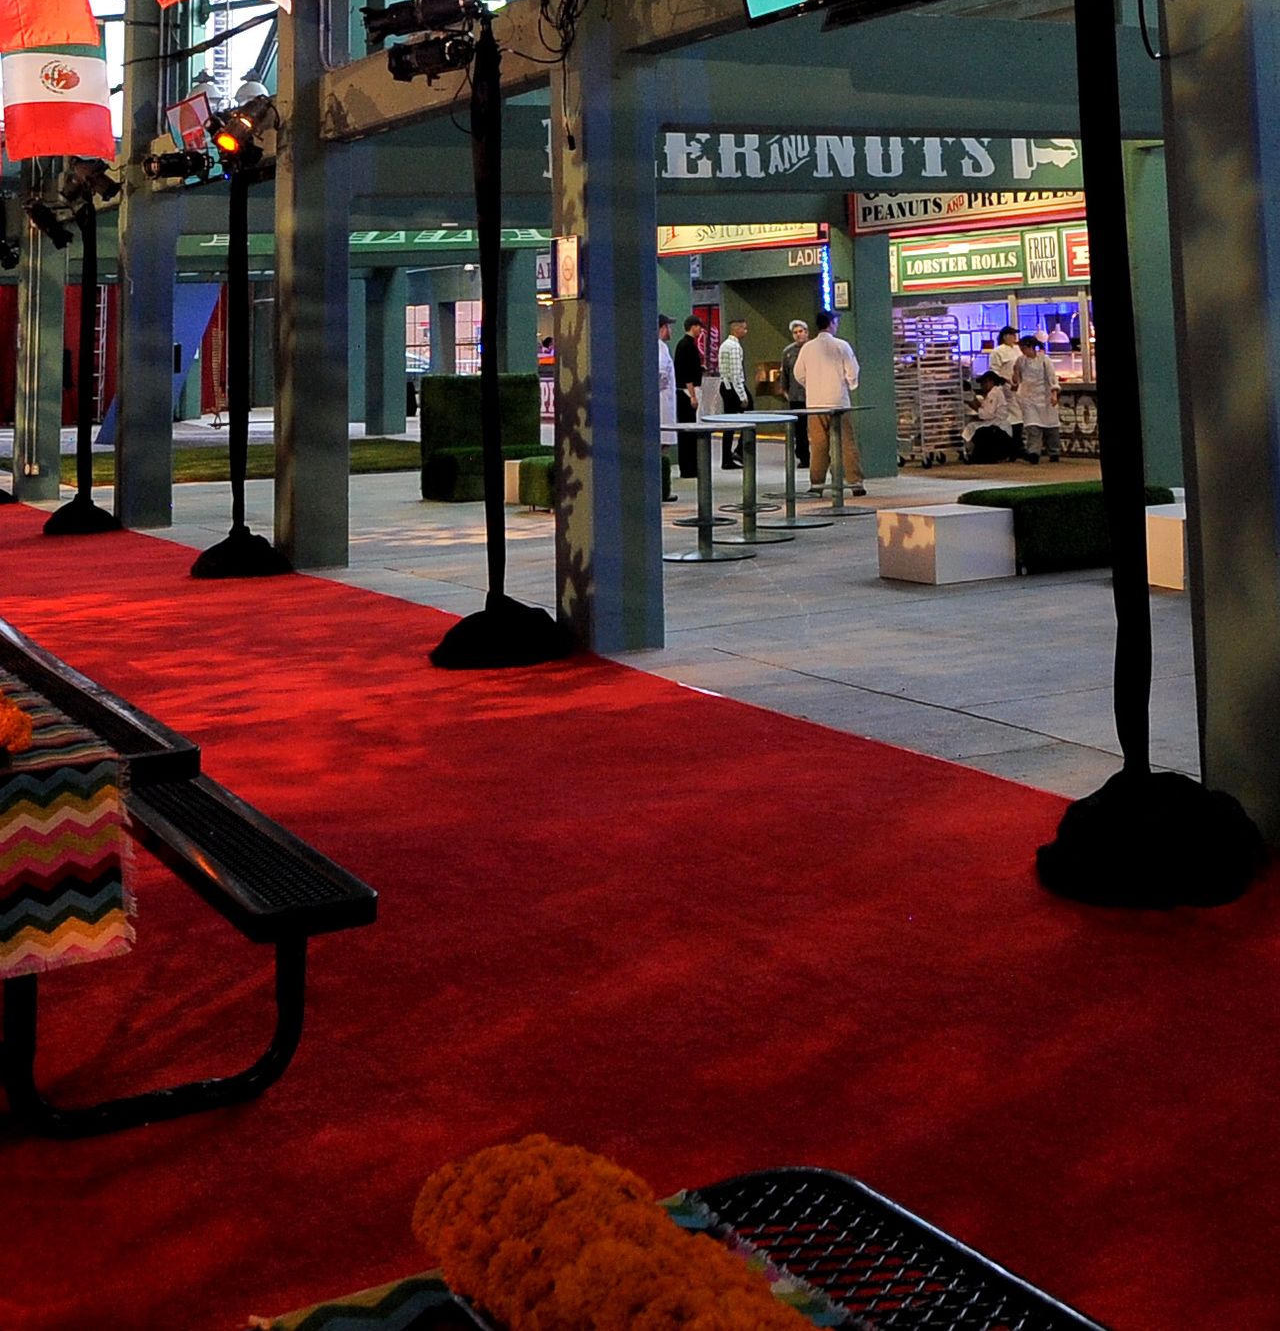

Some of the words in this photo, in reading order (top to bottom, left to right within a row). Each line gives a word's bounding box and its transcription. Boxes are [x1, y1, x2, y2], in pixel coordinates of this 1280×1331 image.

[813, 134, 996, 178] NUTS
[862, 196, 942, 222] PEANUTS
[946, 194, 965, 214] AND
[788, 248, 824, 267] LADIE
[1028, 235, 1055, 260] FRIED
[906, 256, 968, 276] LOBSTER
[971, 251, 1017, 270] ROLLS
[1029, 258, 1058, 280] DOUGH
